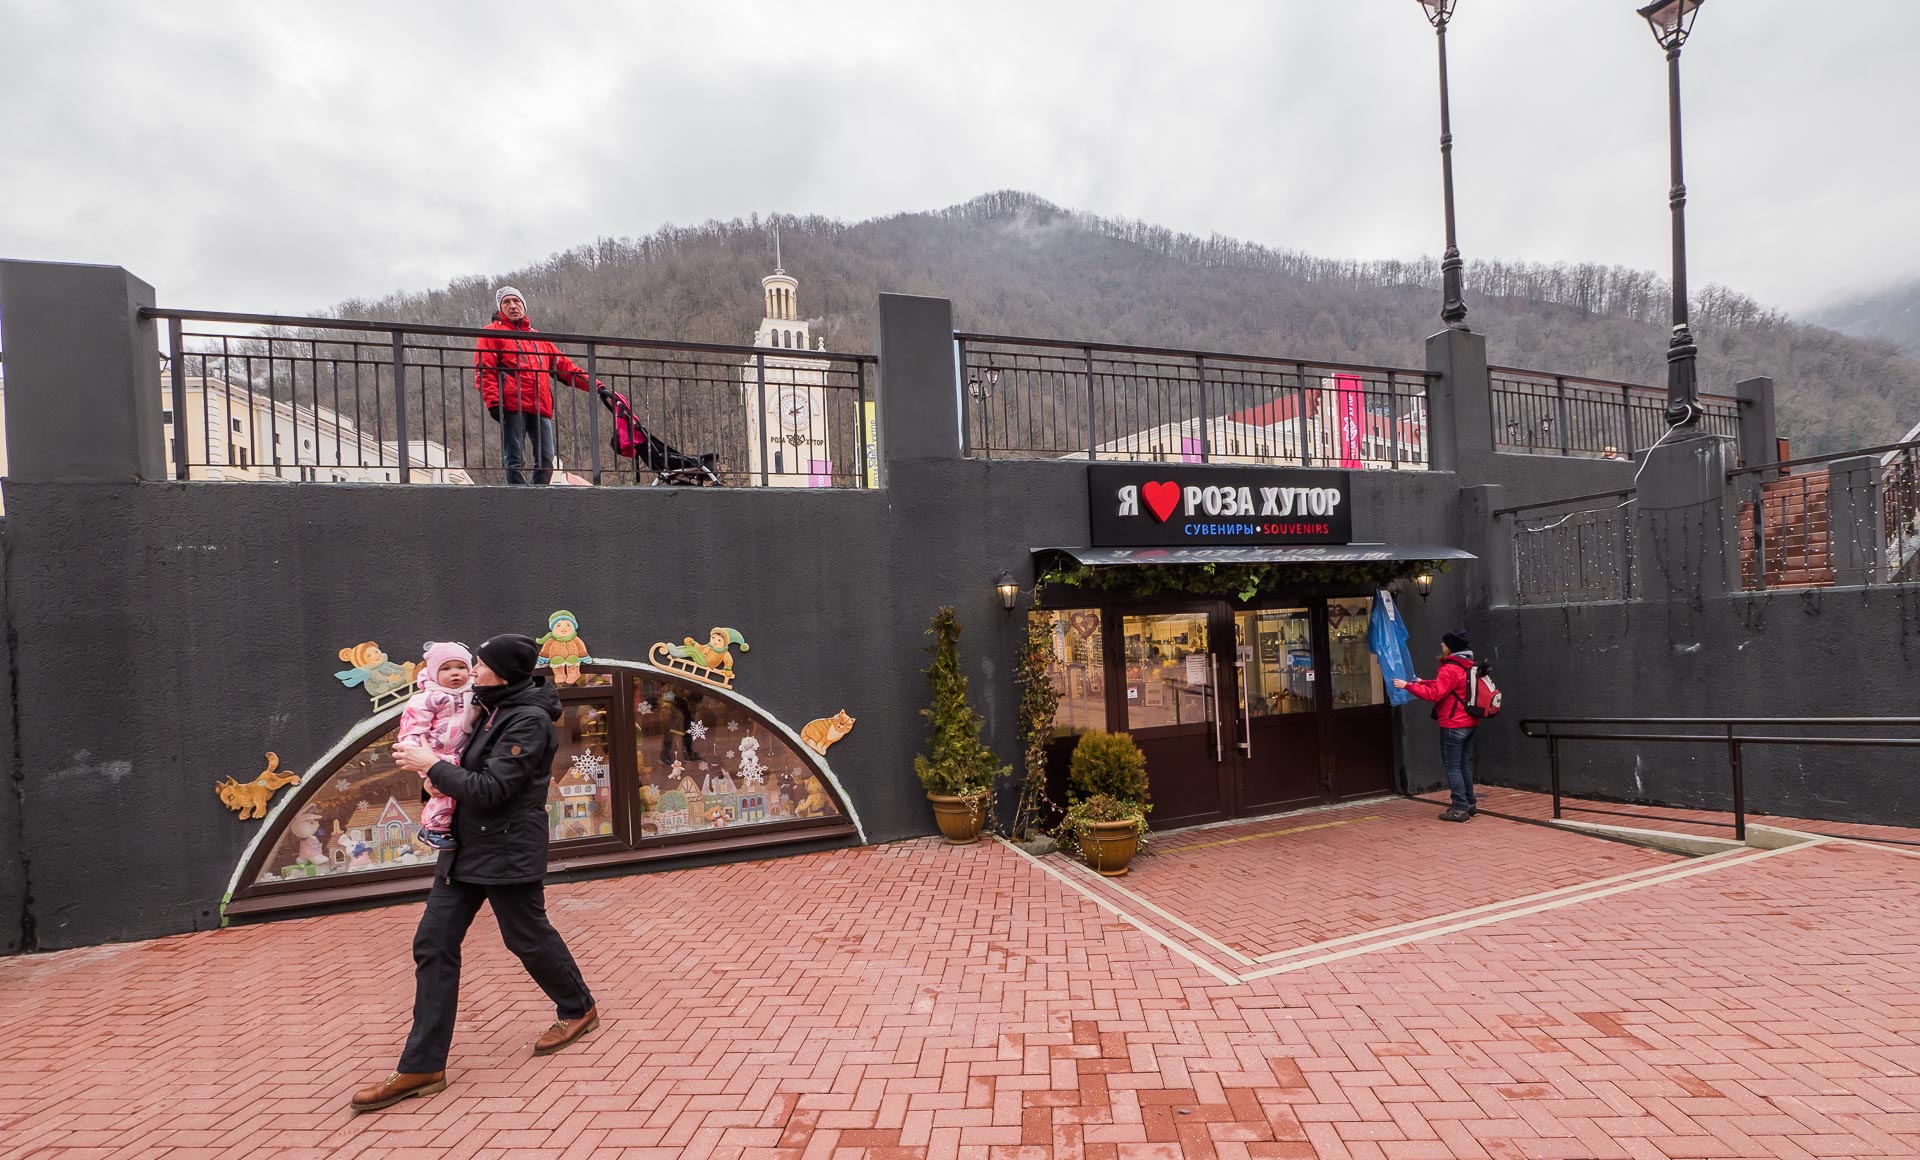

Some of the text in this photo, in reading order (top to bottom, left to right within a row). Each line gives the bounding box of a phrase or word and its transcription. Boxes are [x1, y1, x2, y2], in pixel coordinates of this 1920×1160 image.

[1118, 485, 1340, 516] Я РОЗА ХУТОР
[1184, 523, 1254, 535] СУВЕНИРЫ
[1263, 523, 1329, 535] SOUVENIRS
